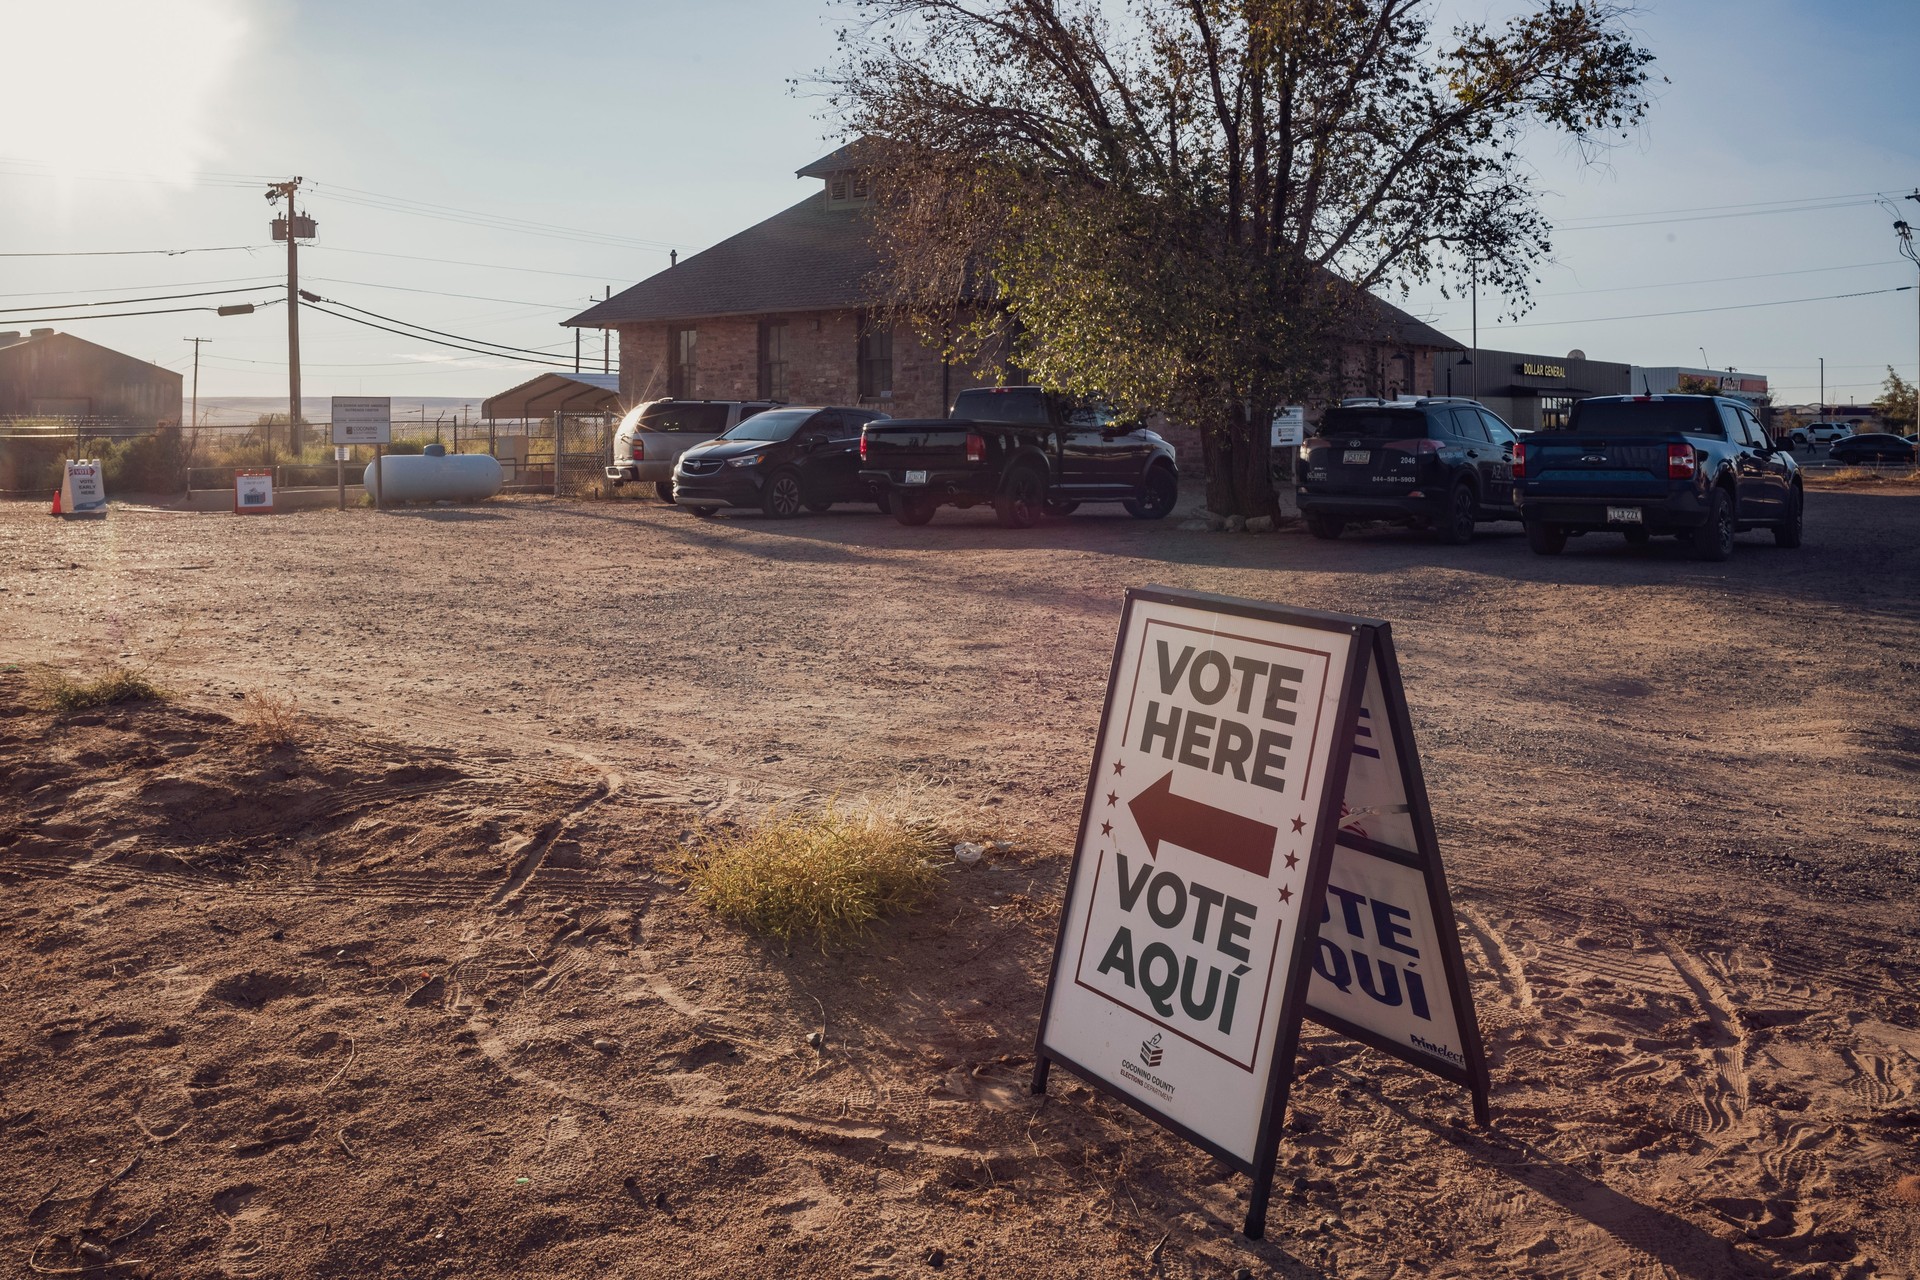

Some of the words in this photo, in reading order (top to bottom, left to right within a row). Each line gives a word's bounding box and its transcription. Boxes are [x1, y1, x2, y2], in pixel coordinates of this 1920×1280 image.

[1524, 363, 1544, 376] DOLLAR
[1545, 365, 1566, 378] GENERAL
[1400, 456, 1416, 464] 2046
[1156, 640, 1304, 725] VOTE
[1140, 701, 1293, 793] HERE
[1116, 853, 1258, 963] VOTE
[1097, 926, 1252, 1035] AQUÍ
[1312, 936, 1432, 1021] QUÍ
[1120, 1069, 1143, 1086] ELECTIONS
[1144, 1083, 1173, 1103] DEPARTMENT
[1122, 1060, 1151, 1080] COCONINO
[1152, 1076, 1175, 1094] COUNTY
